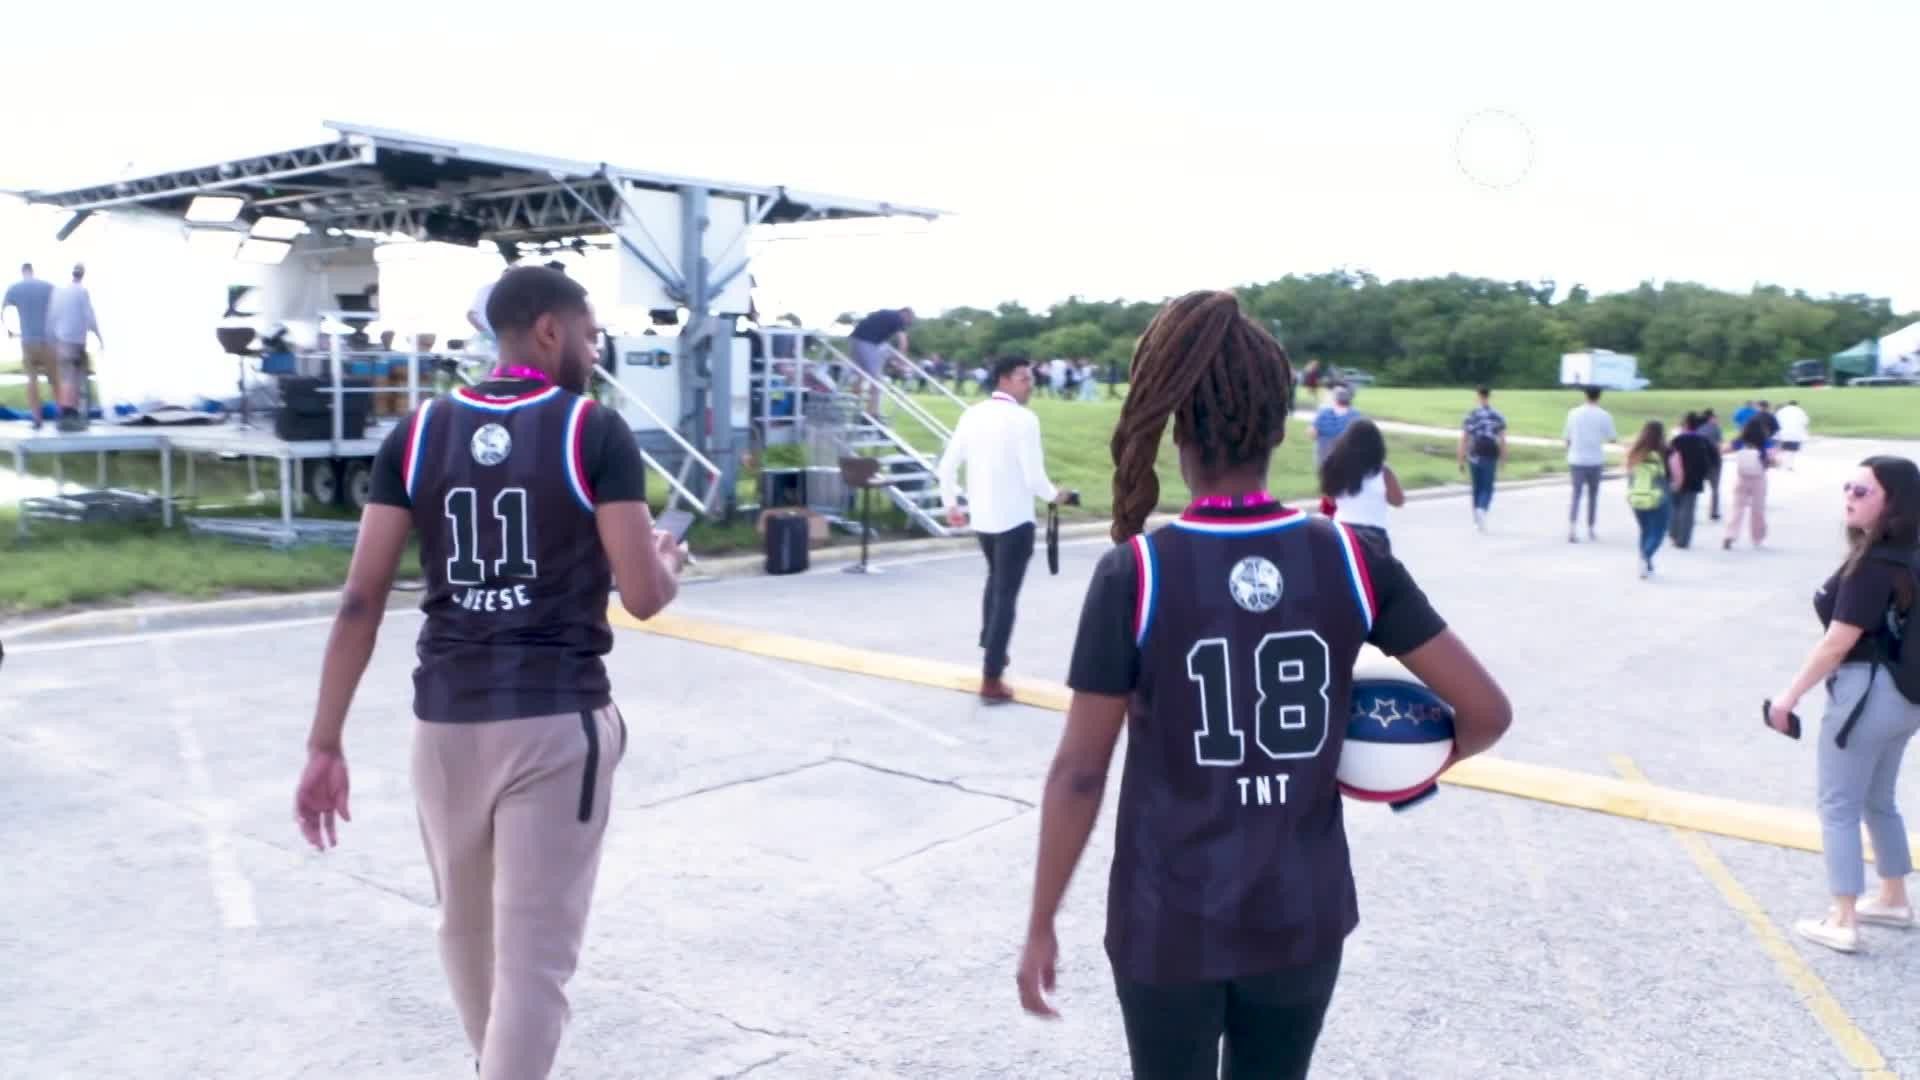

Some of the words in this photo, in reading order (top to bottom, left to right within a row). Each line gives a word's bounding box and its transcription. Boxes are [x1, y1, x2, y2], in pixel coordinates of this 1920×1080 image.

[444, 487, 537, 584] 11
[1186, 630, 1330, 766] 18
[1236, 773, 1290, 805] TNT
